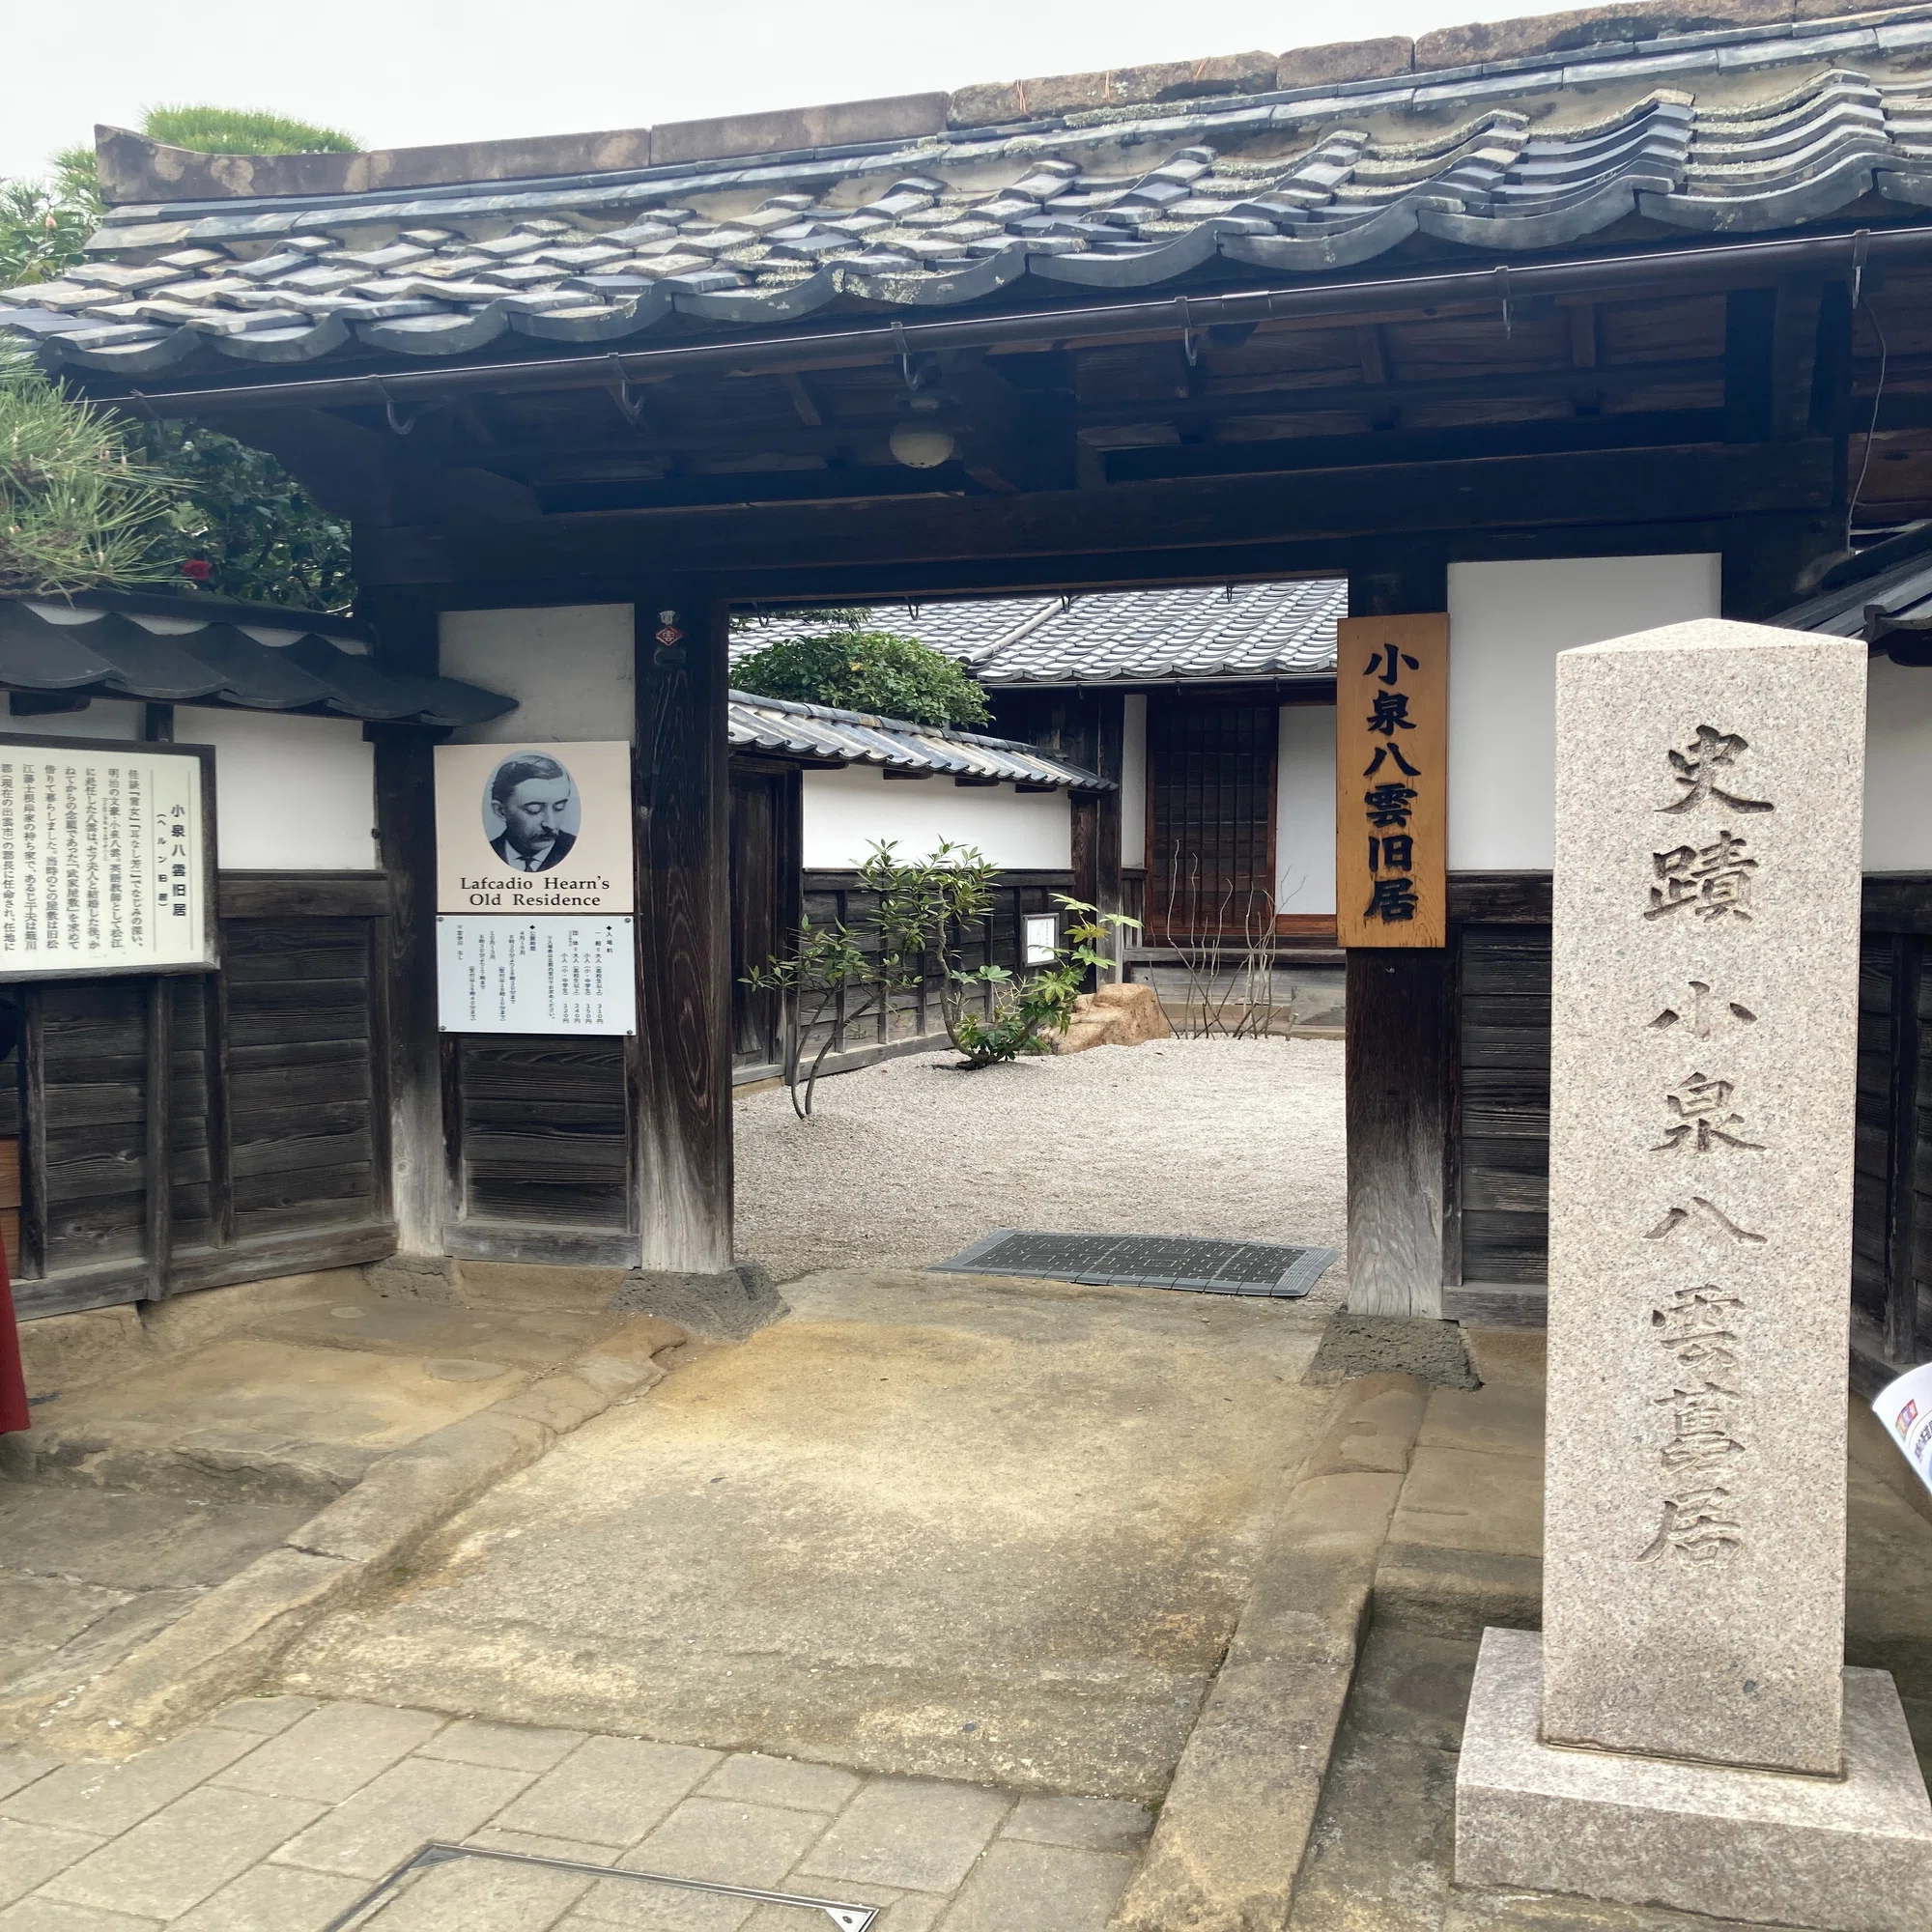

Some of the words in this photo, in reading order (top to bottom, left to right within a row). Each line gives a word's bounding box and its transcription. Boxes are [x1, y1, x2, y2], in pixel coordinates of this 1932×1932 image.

[1363, 642, 1422, 925] 小泉八雲旧居
[171, 804, 186, 917] 小泉八雲旧居
[460, 877, 533, 890] Lafcadio
[543, 875, 611, 890] Hearn's
[469, 894, 501, 906] Old
[513, 894, 601, 906] Residence
